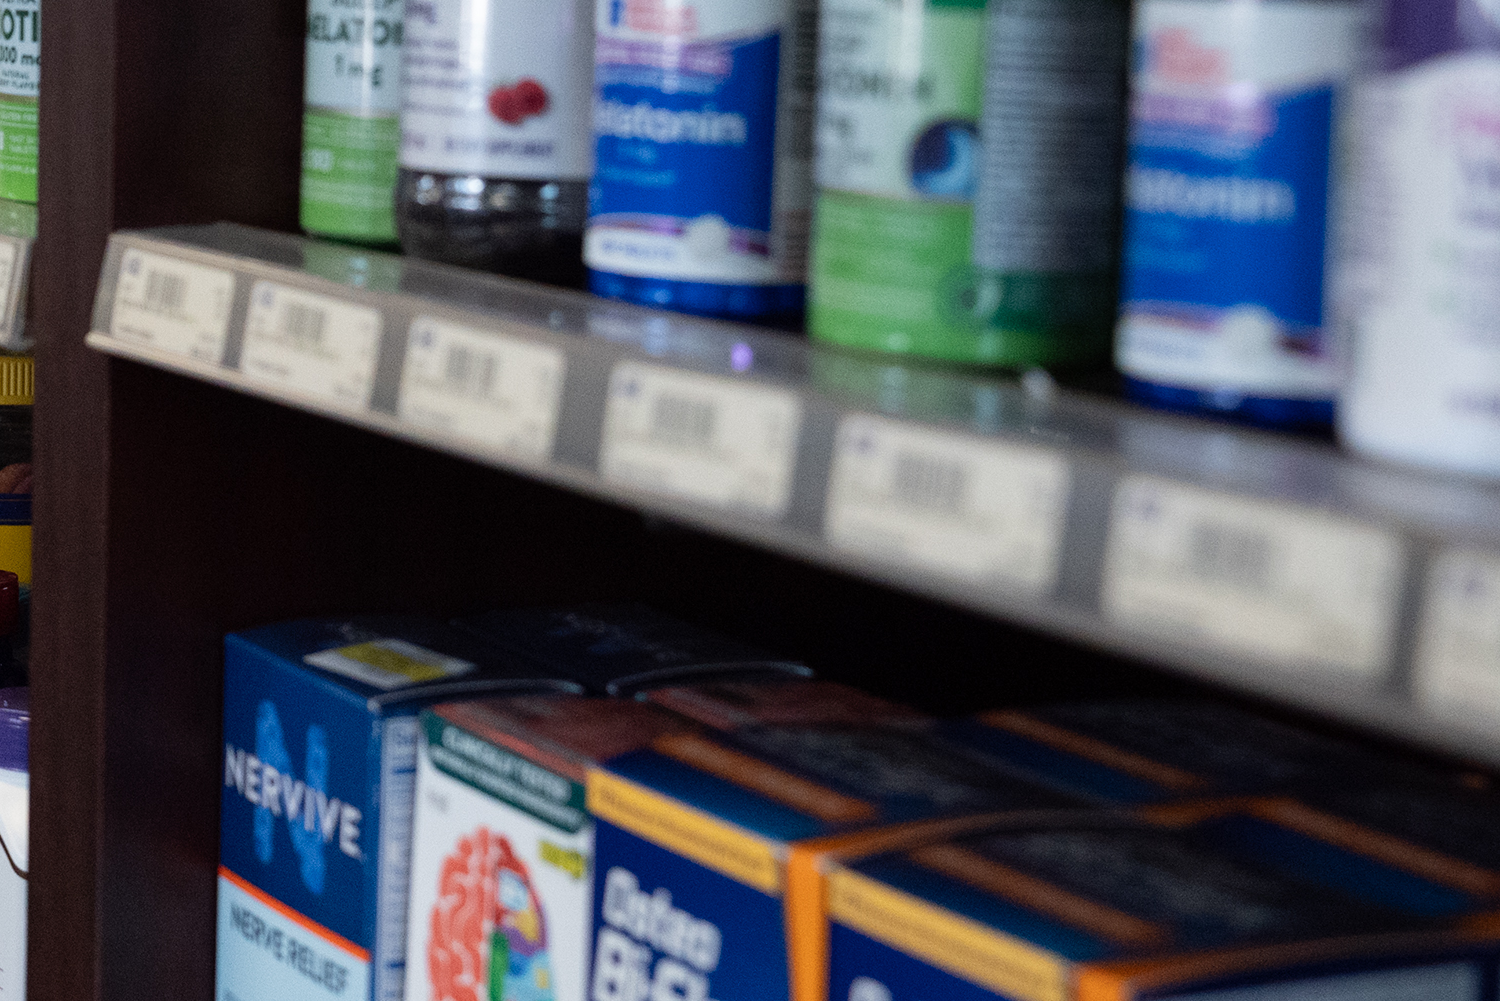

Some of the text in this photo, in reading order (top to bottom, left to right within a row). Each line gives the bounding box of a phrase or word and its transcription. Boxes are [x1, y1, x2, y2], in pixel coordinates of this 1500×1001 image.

[224, 742, 364, 860] NERVIVE
[229, 901, 350, 995] NERVE RELIEF
